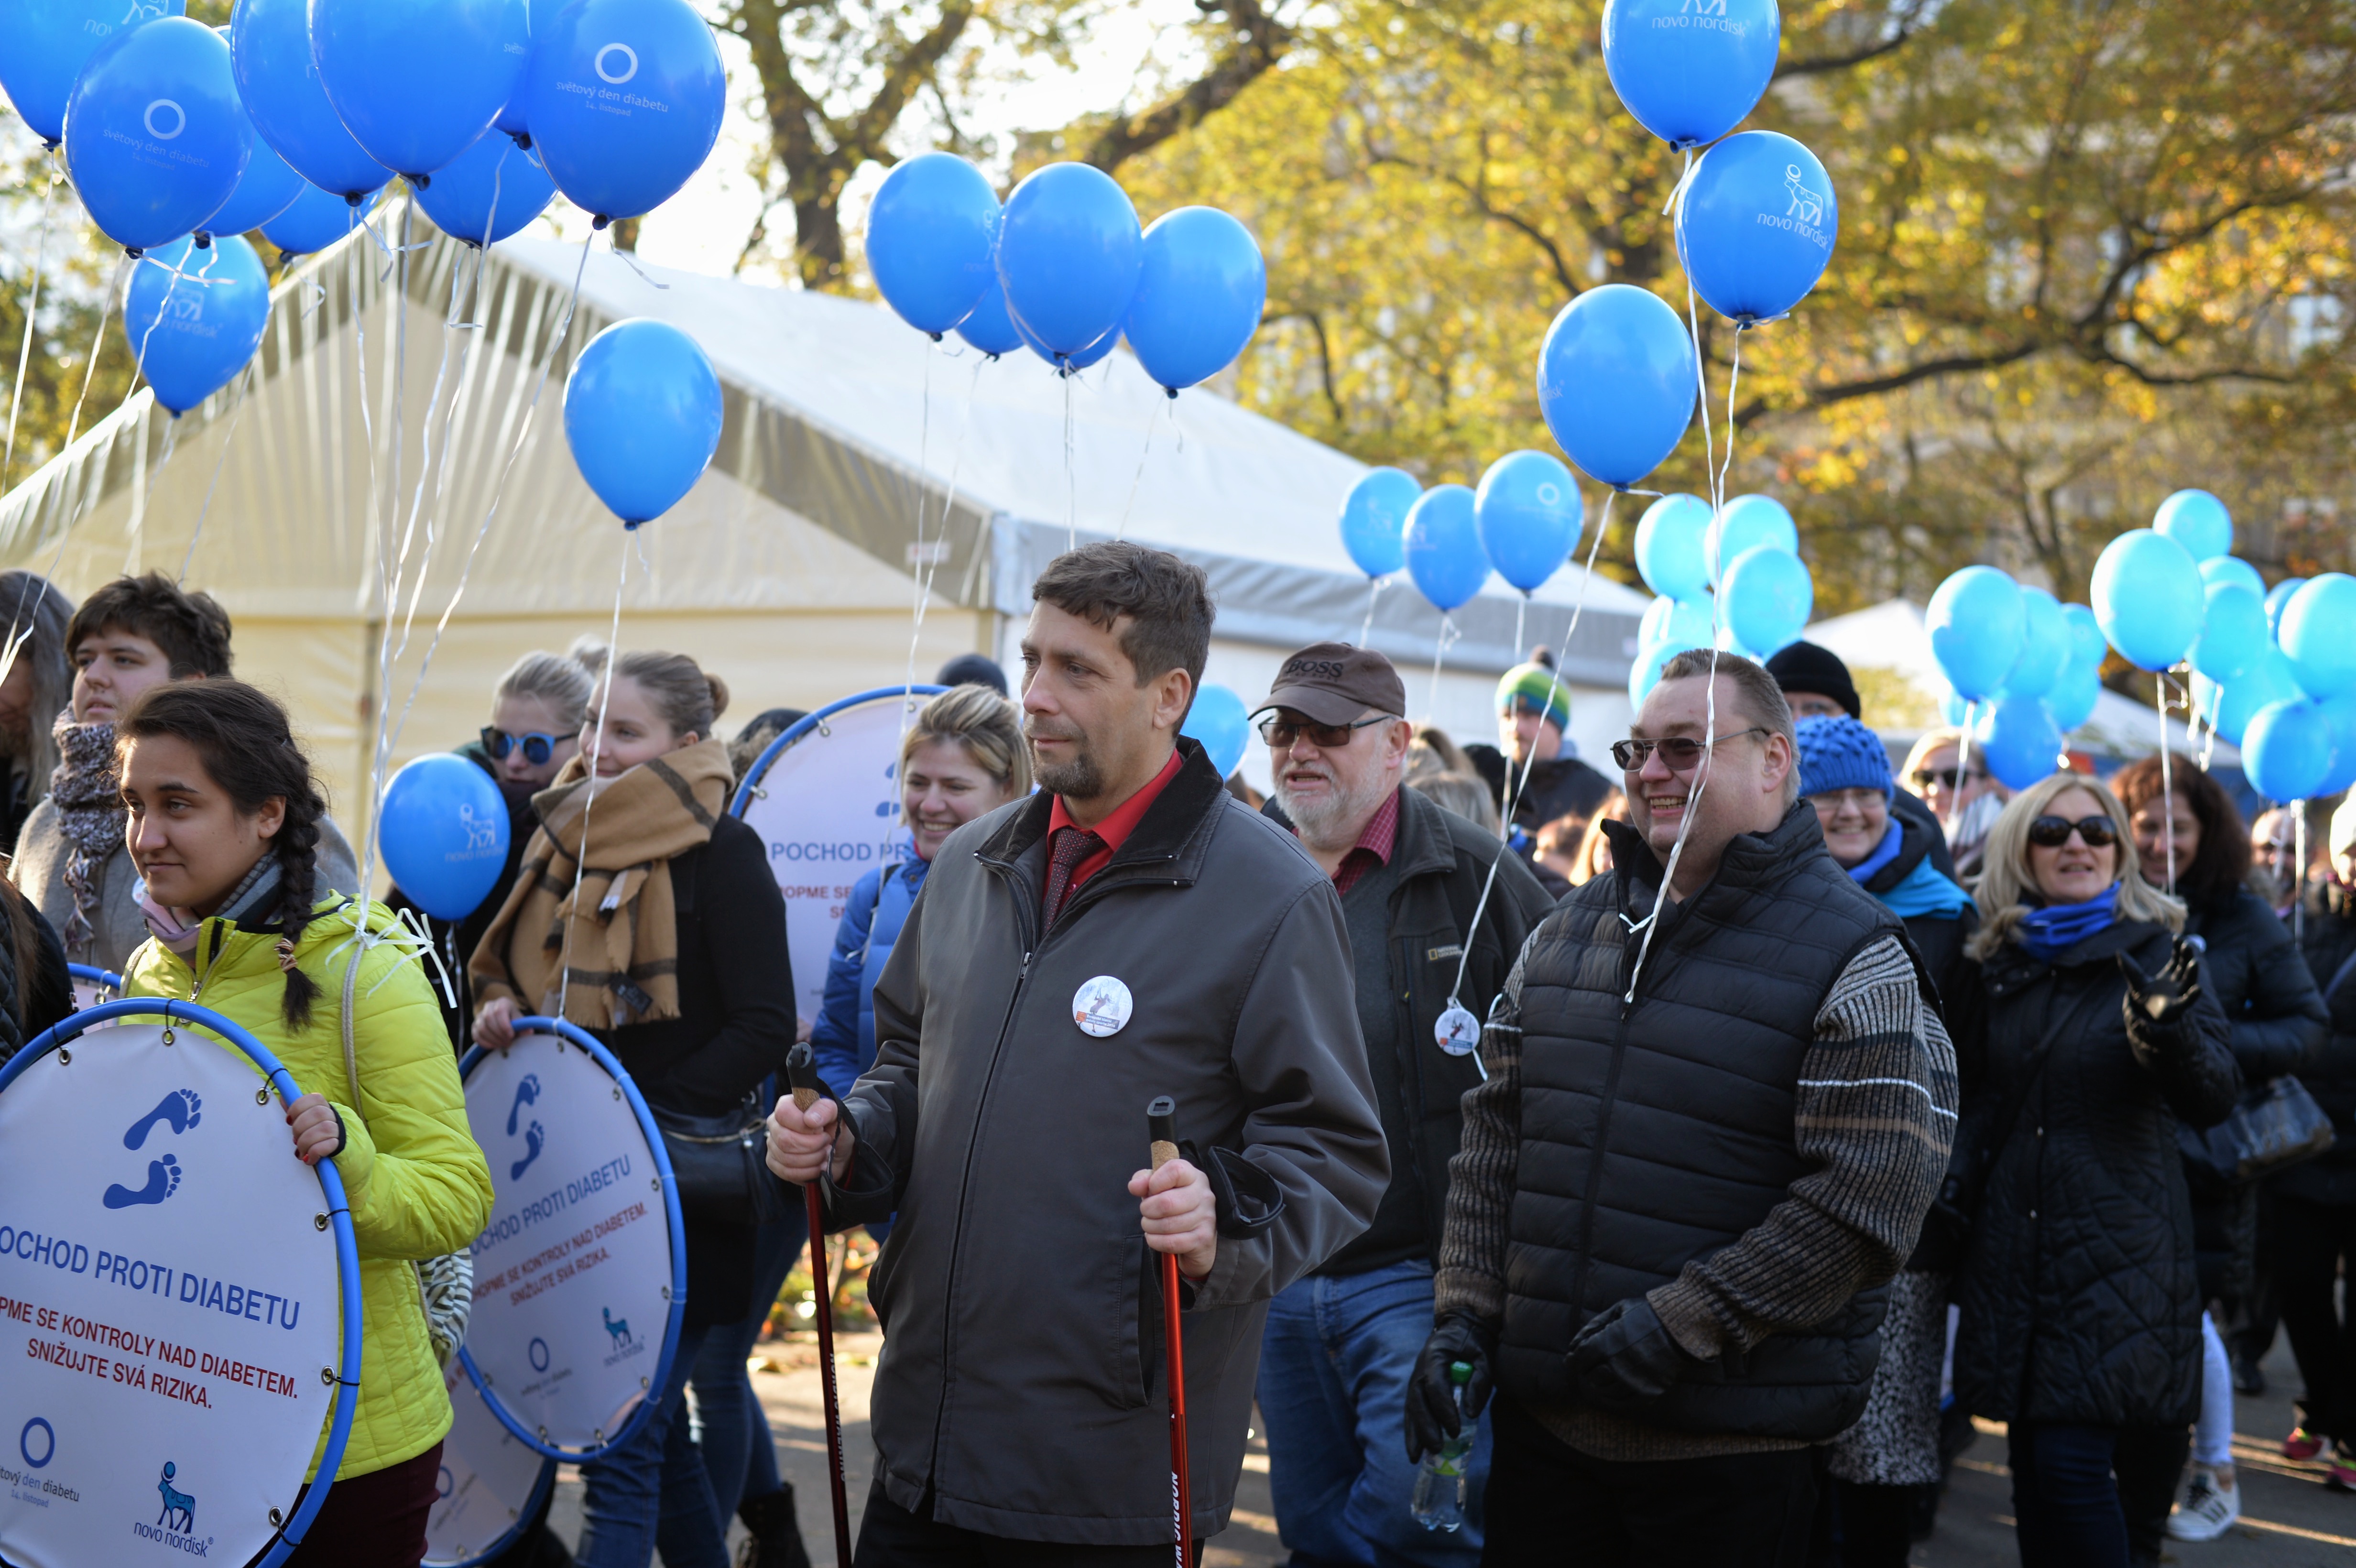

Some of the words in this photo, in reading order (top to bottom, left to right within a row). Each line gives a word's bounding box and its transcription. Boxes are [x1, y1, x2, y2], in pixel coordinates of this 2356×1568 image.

[1652, 16, 1689, 29] novo
[1693, 16, 1746, 37] nordisk
[556, 81, 596, 98] světový
[598, 88, 620, 101] den
[623, 93, 669, 112] diabetu
[585, 101, 597, 110] 14.
[599, 104, 632, 117] listopad
[103, 129, 144, 151] světový
[145, 142, 167, 156] den
[169, 150, 209, 168] diabetu
[1757, 213, 1792, 230] novo
[1794, 222, 1829, 251] nordisk
[1285, 660, 1343, 677] BOSS
[771, 842, 872, 861] POCHOD
[522, 1189, 567, 1228] PROTI
[567, 1154, 631, 1204] DIABETU
[571, 1228, 593, 1250] NAD
[593, 1201, 647, 1239] DIABETEM.
[0, 1226, 89, 1274] OCHOD
[95, 1250, 173, 1297] PROTI
[180, 1272, 300, 1330] DIABETU
[0, 1296, 33, 1323] PME
[36, 1307, 59, 1331] SE
[62, 1314, 156, 1357] KONTROLY
[158, 1340, 196, 1368] NAD
[200, 1352, 298, 1399] DIABETEM.
[27, 1338, 109, 1379] SNIŽUJTE
[112, 1364, 146, 1390] SVÁ
[151, 1372, 212, 1409] RIZIKA.
[0, 1466, 21, 1486] tový
[22, 1473, 41, 1490] den
[43, 1479, 80, 1502] diabetu
[11, 1489, 21, 1500] 14.
[22, 1492, 50, 1508] listopad
[1171, 1471, 1181, 1542] NORDIC
[134, 1522, 163, 1542] novo
